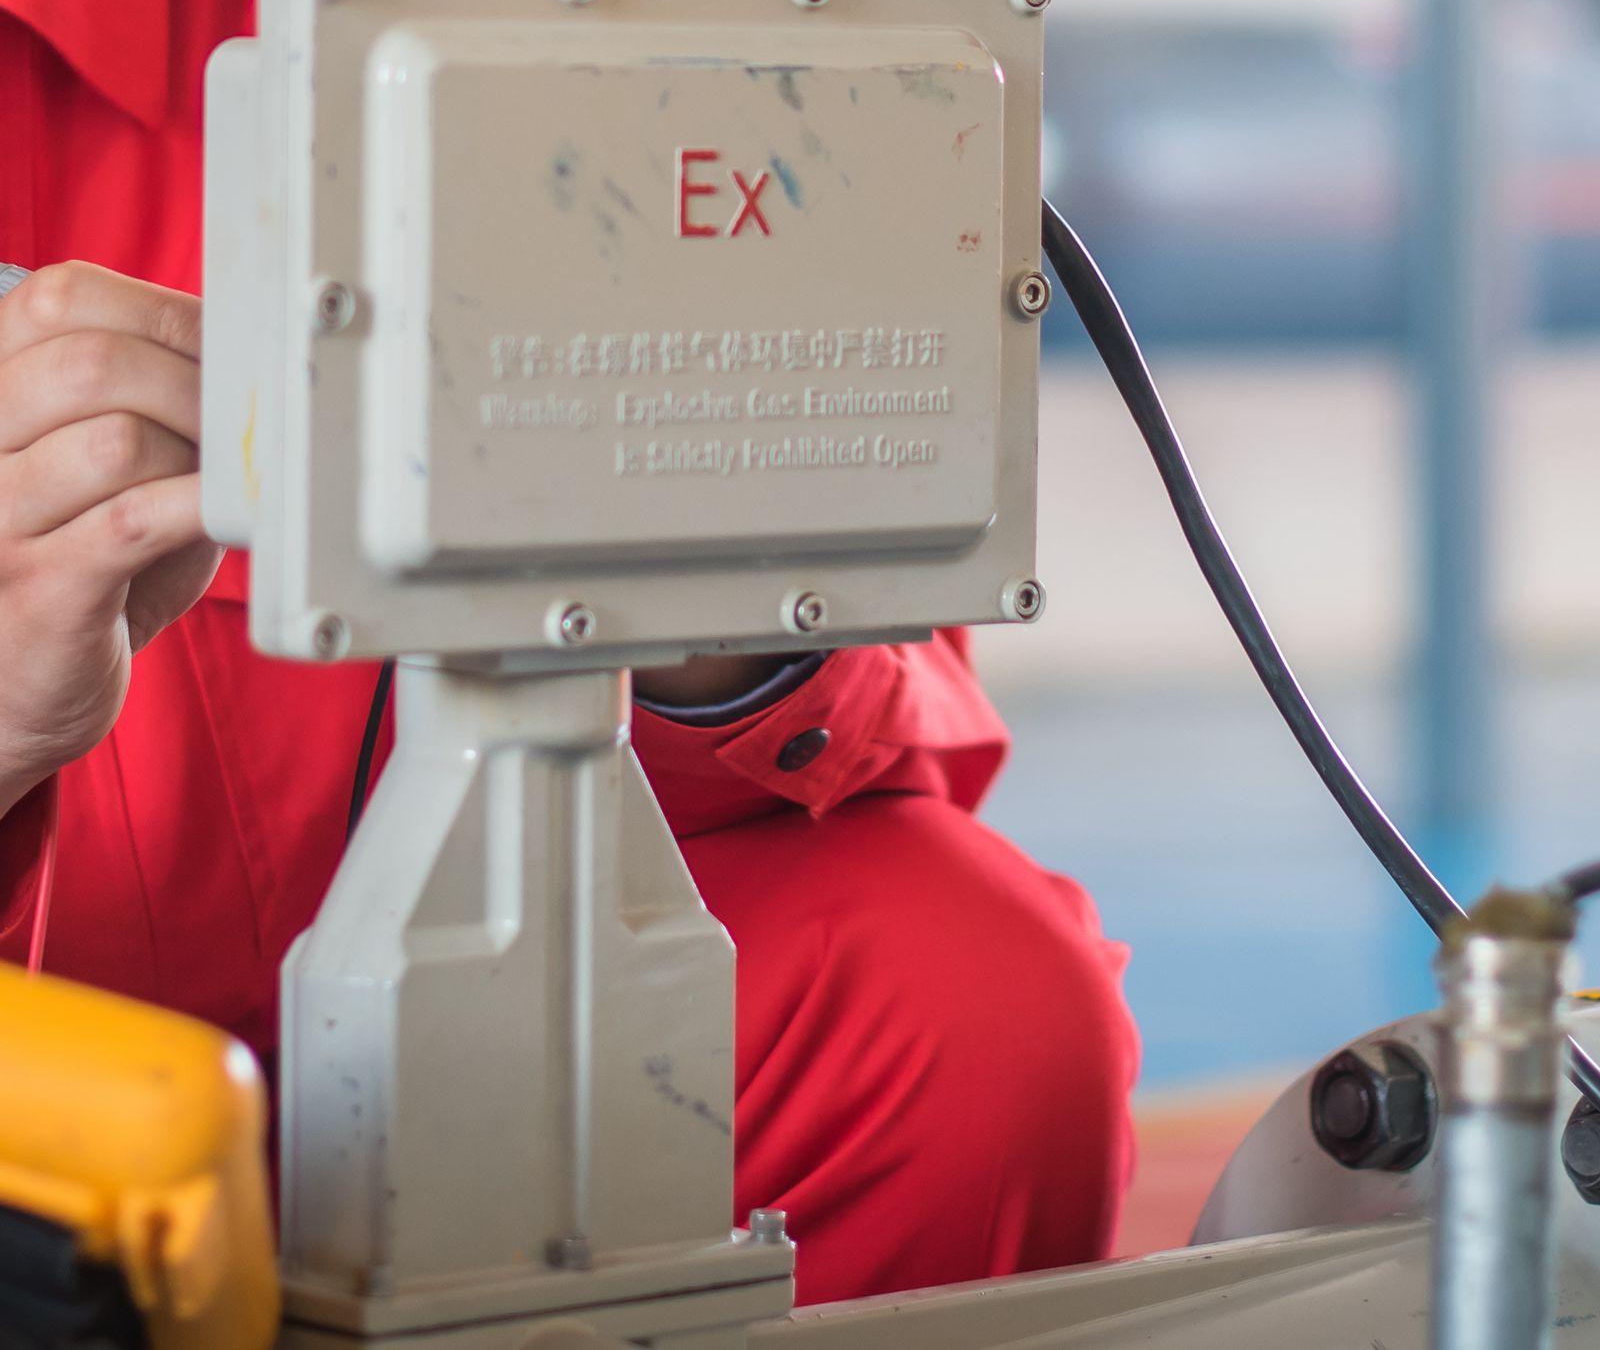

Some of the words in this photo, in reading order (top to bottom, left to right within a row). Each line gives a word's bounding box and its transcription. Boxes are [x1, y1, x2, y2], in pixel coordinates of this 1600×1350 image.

[674, 147, 771, 238] Ex
[616, 388, 738, 427] Explosive
[747, 387, 796, 418] Gas
[803, 385, 949, 417] Environment
[743, 435, 866, 469] Prohibited
[873, 434, 934, 468] Open
